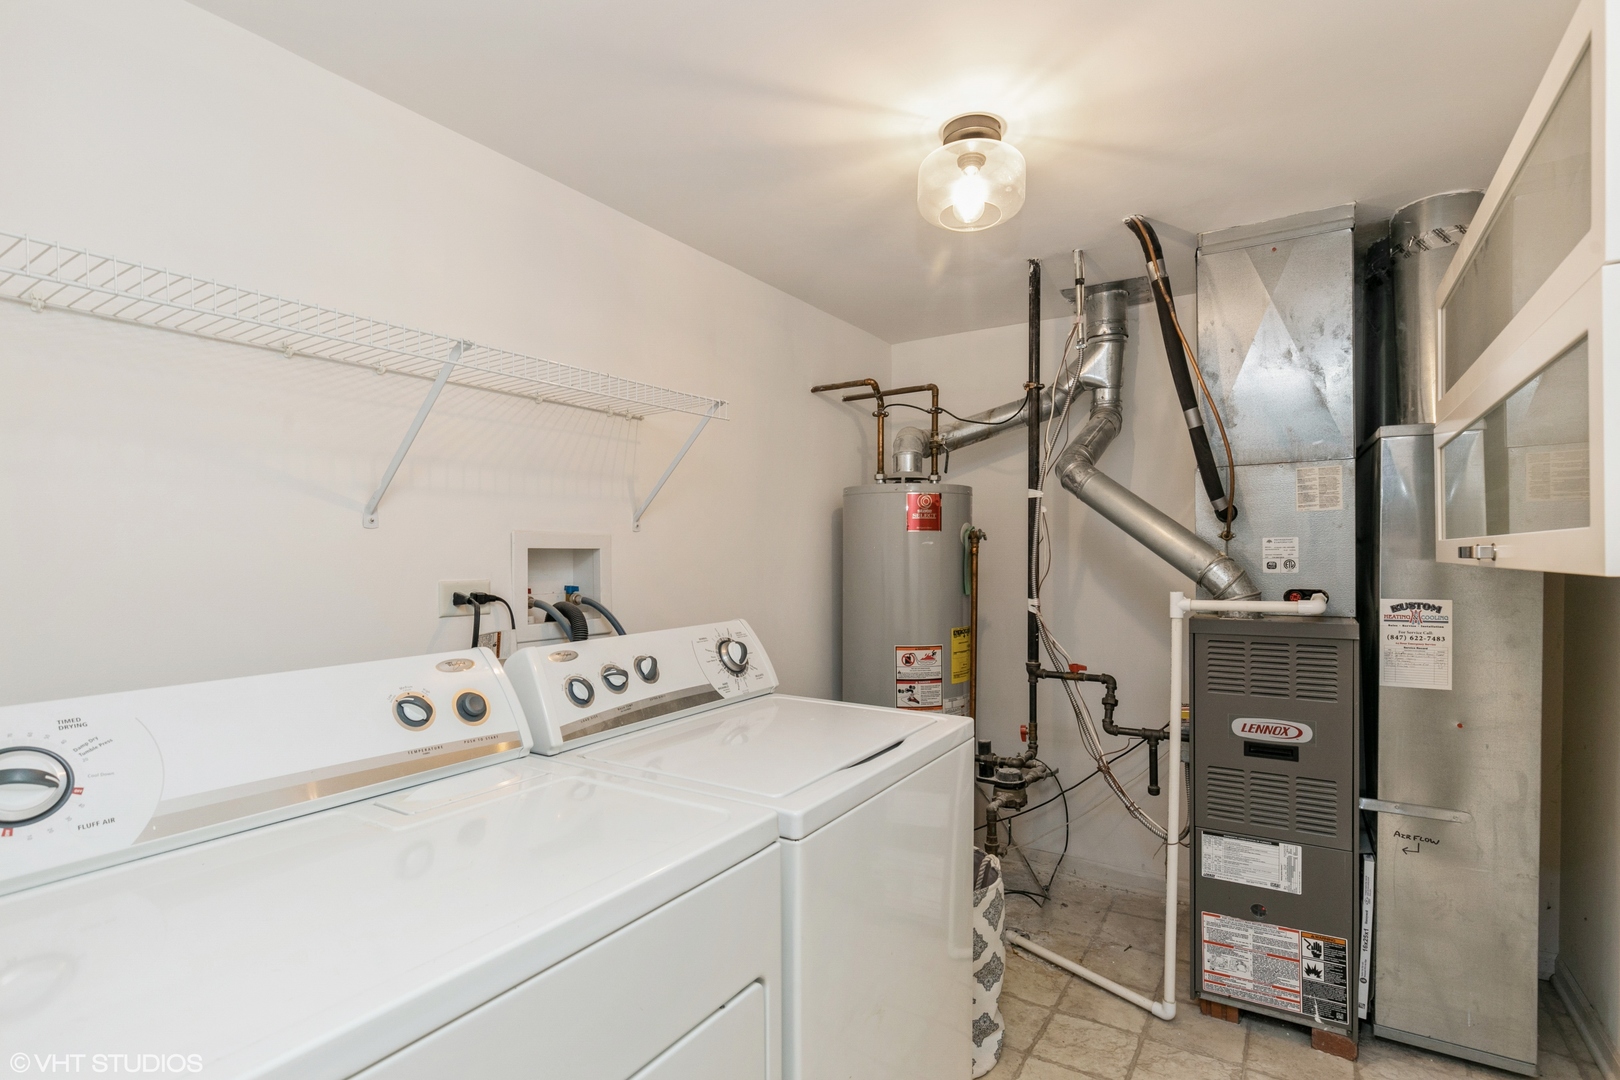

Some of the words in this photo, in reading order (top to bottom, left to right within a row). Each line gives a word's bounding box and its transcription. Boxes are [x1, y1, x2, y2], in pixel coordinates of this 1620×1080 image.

[1390, 602, 1442, 614] KUSTOM
[57, 717, 82, 725] TIMED
[58, 722, 88, 731] DRYING
[1241, 723, 1291, 737] LENNOX
[73, 741, 89, 752] Damp
[88, 736, 99, 744] Dry
[78, 746, 98, 757] Tumble
[98, 738, 113, 748] Press
[407, 745, 443, 755] TEMPERATURE
[77, 821, 100, 831] FLUFF
[102, 817, 116, 826] AIR
[1361, 927, 1370, 953] 16x25x1
